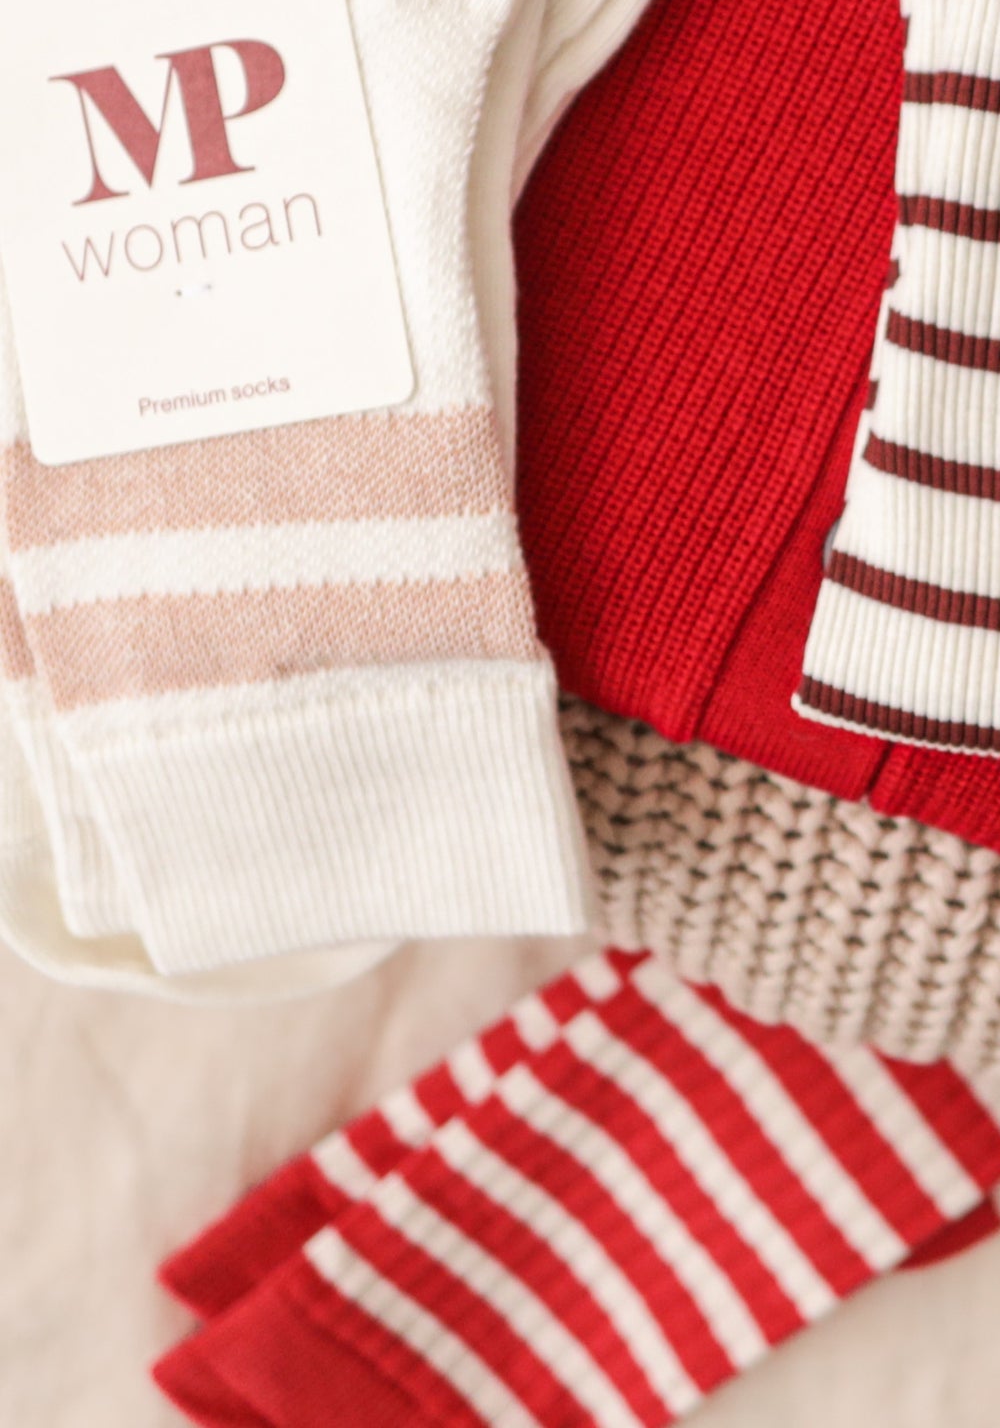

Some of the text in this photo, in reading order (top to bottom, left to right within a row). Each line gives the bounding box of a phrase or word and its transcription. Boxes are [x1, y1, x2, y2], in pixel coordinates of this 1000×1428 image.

[48, 37, 286, 207] MP
[61, 192, 322, 282] woman
[138, 376, 290, 417] Premium socks
